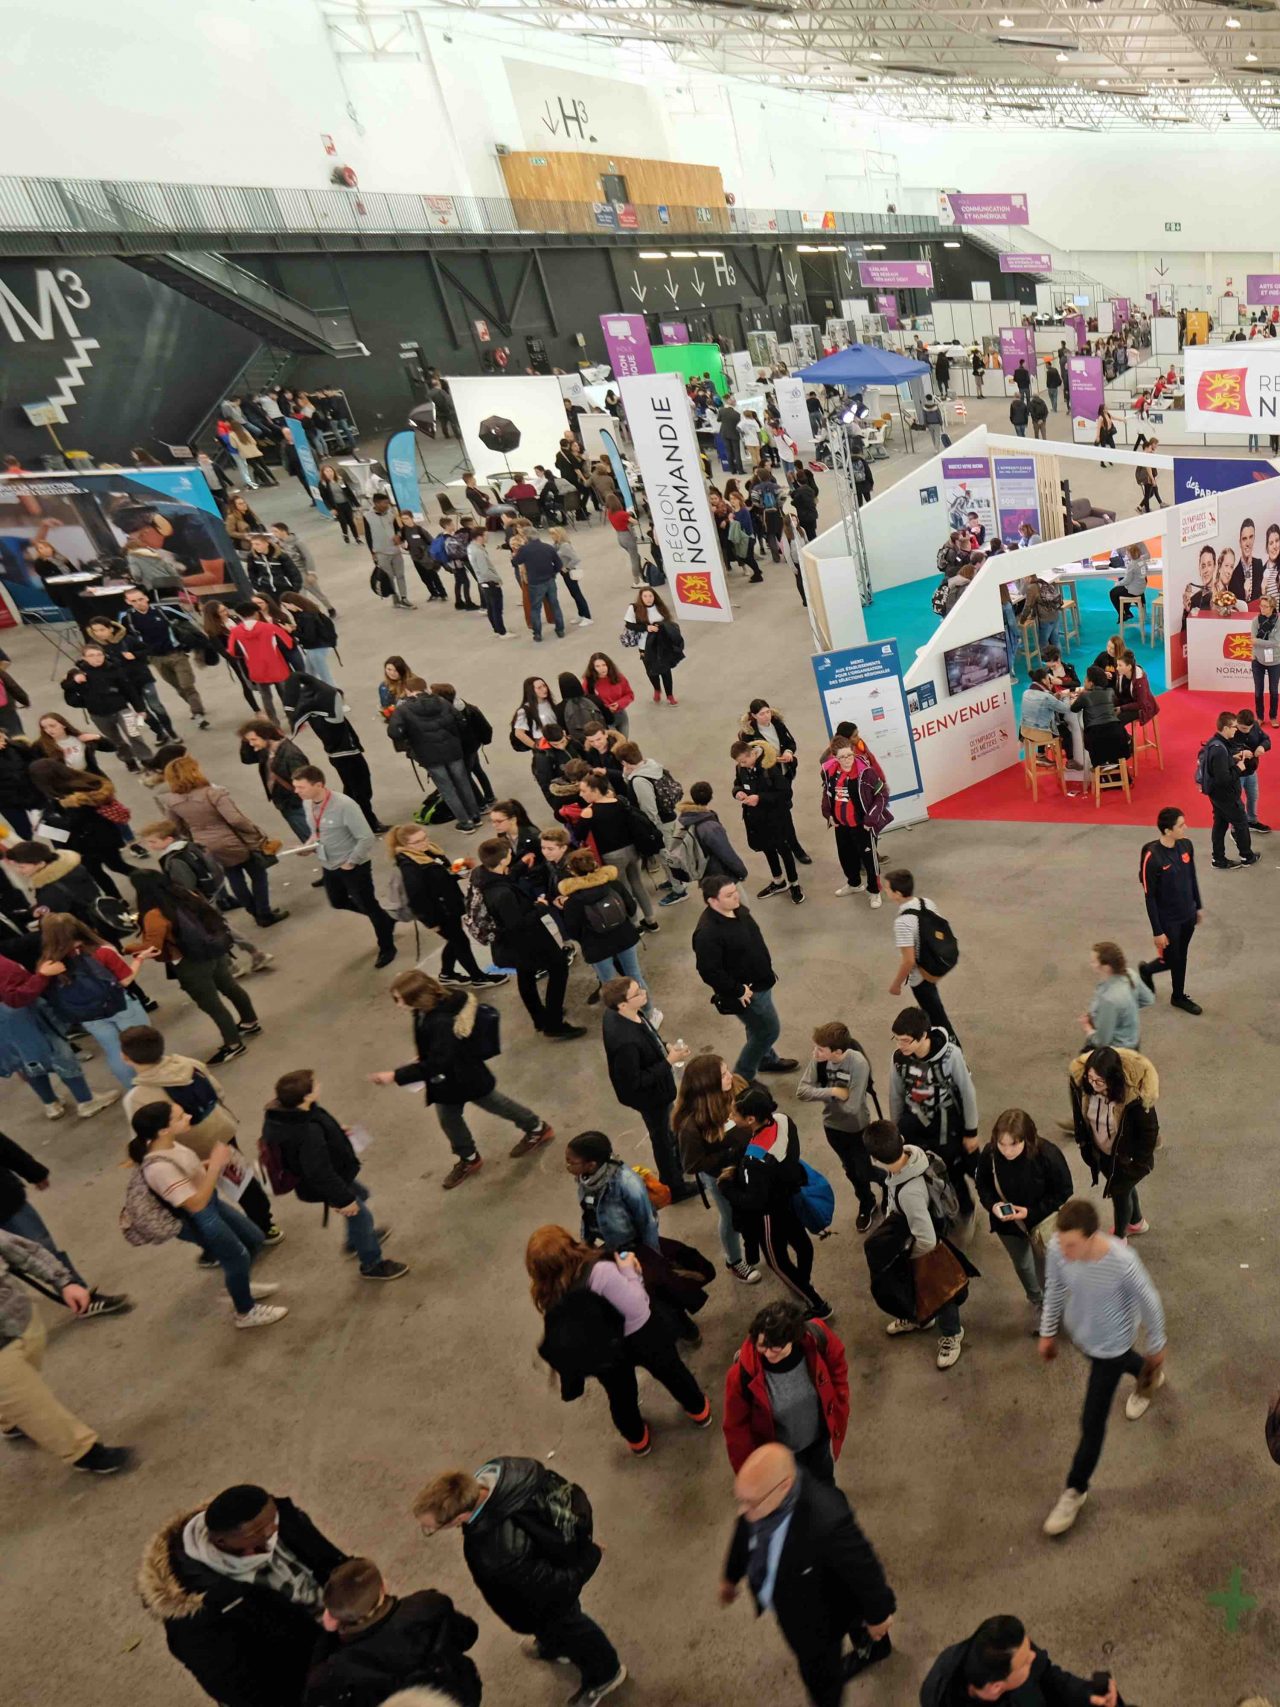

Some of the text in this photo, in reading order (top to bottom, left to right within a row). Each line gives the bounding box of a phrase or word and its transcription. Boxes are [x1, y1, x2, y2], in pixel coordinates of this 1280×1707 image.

[651, 396, 706, 564] NORMANDIE
[655, 483, 686, 563] RÉGION
[911, 695, 1001, 743] BIENVENUE
